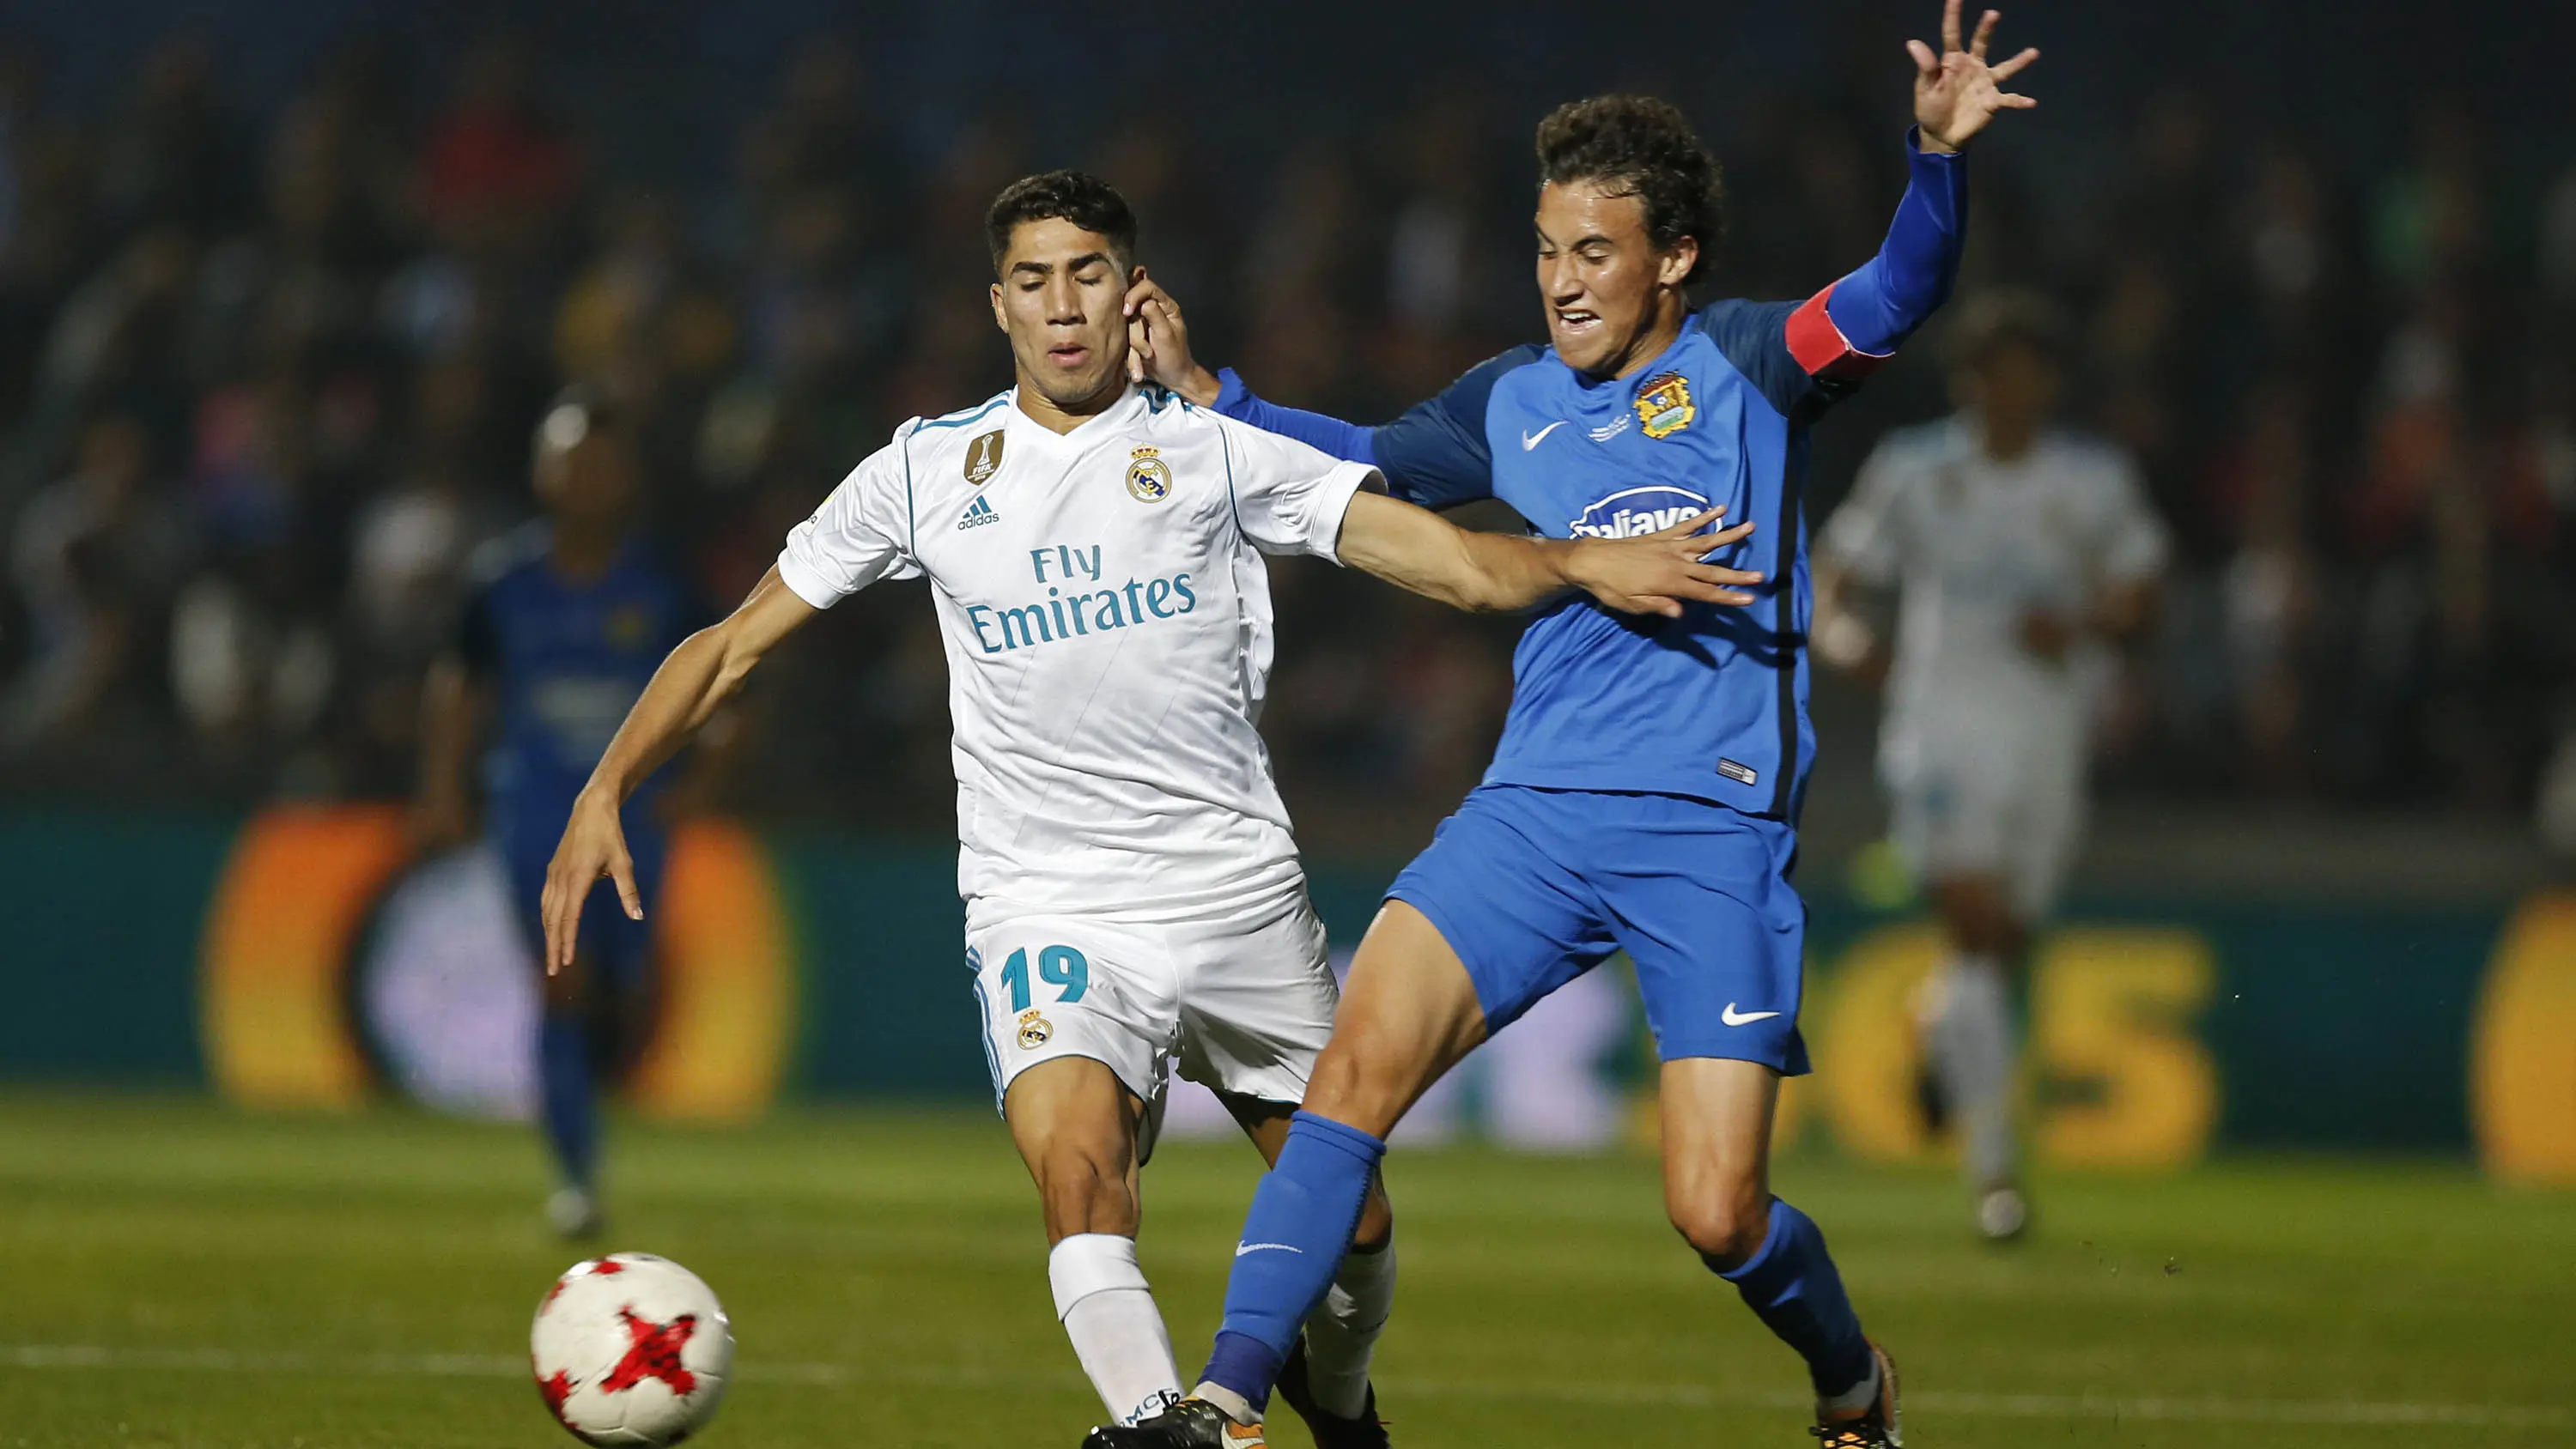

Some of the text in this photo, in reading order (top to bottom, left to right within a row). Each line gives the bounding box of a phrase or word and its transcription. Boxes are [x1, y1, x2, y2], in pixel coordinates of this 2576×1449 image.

[973, 464, 991, 475] FIFA
[957, 513, 999, 530] adidas
[1030, 544, 1101, 584] Fly
[966, 573, 1196, 653] Emirates
[1000, 945, 1088, 1014] 19
